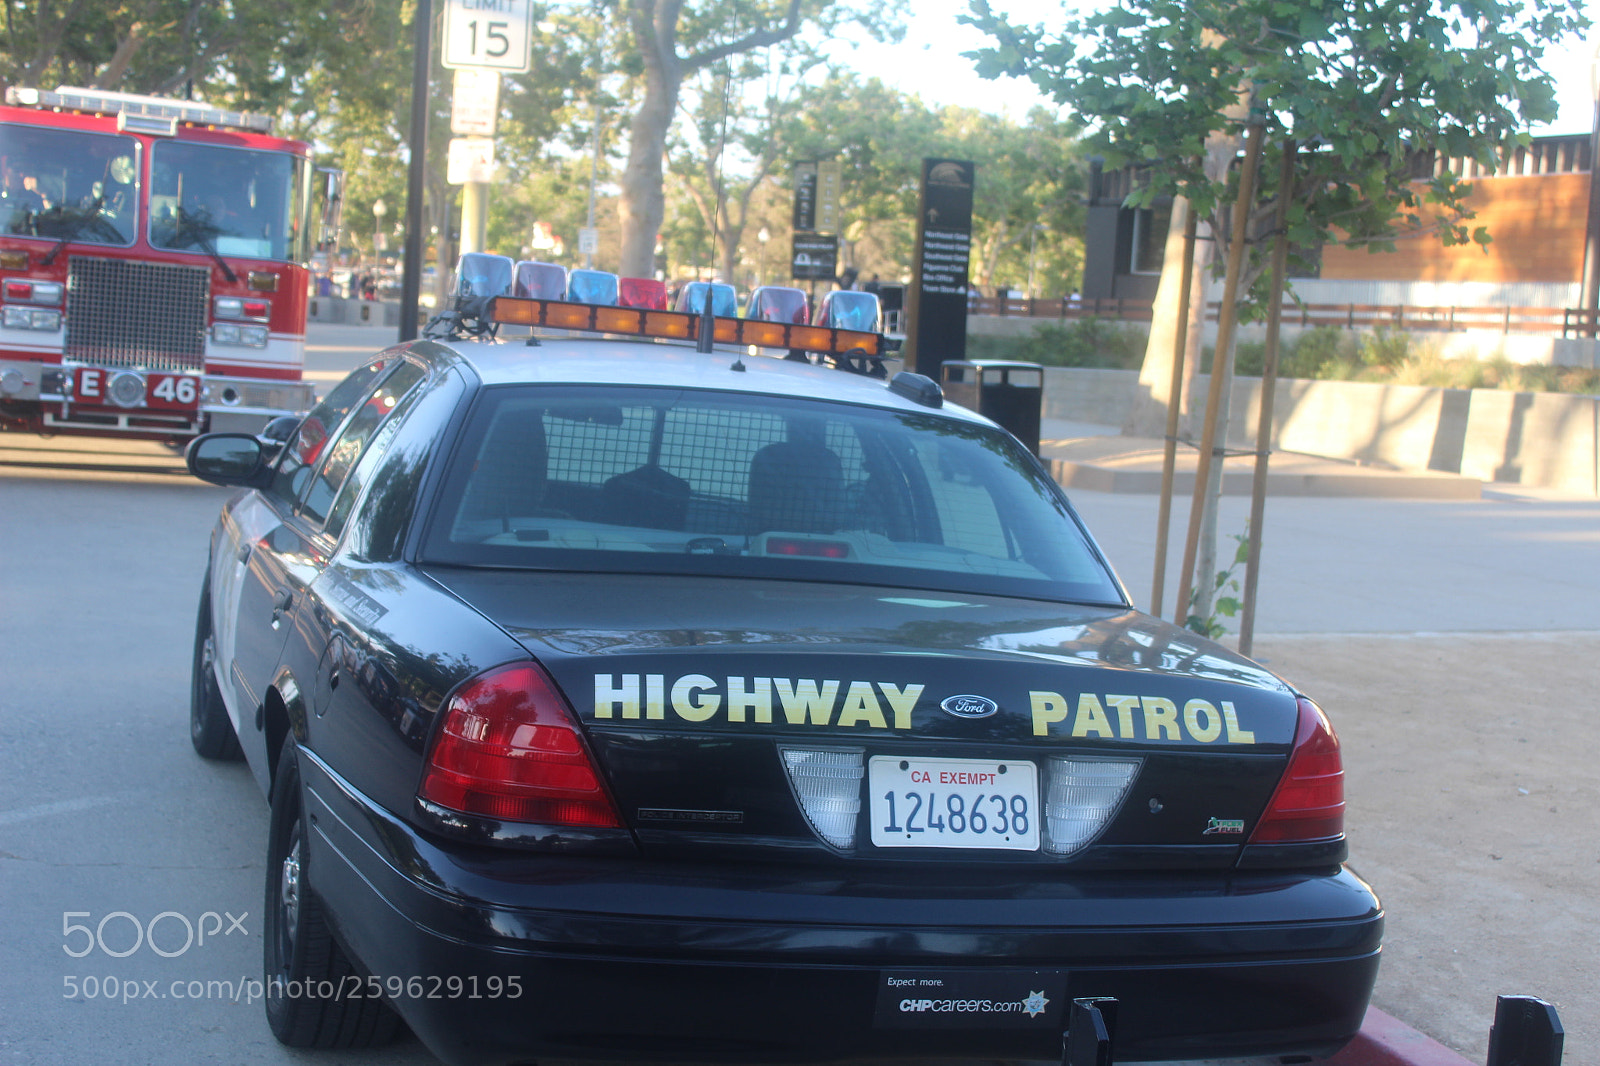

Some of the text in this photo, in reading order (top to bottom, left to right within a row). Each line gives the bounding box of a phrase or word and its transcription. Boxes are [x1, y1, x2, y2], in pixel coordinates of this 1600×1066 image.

[462, 0, 514, 12] LIMIT
[468, 20, 509, 57] 15
[80, 370, 100, 396] E
[153, 376, 196, 403] 46
[594, 673, 925, 729] HIGHWAY
[1028, 691, 1255, 744] PATROL
[911, 771, 996, 785] CA EXEMPT
[884, 790, 1029, 835] 1248638
[887, 977, 944, 988] Expect more.
[899, 998, 1022, 1012] CHPcareers.com
